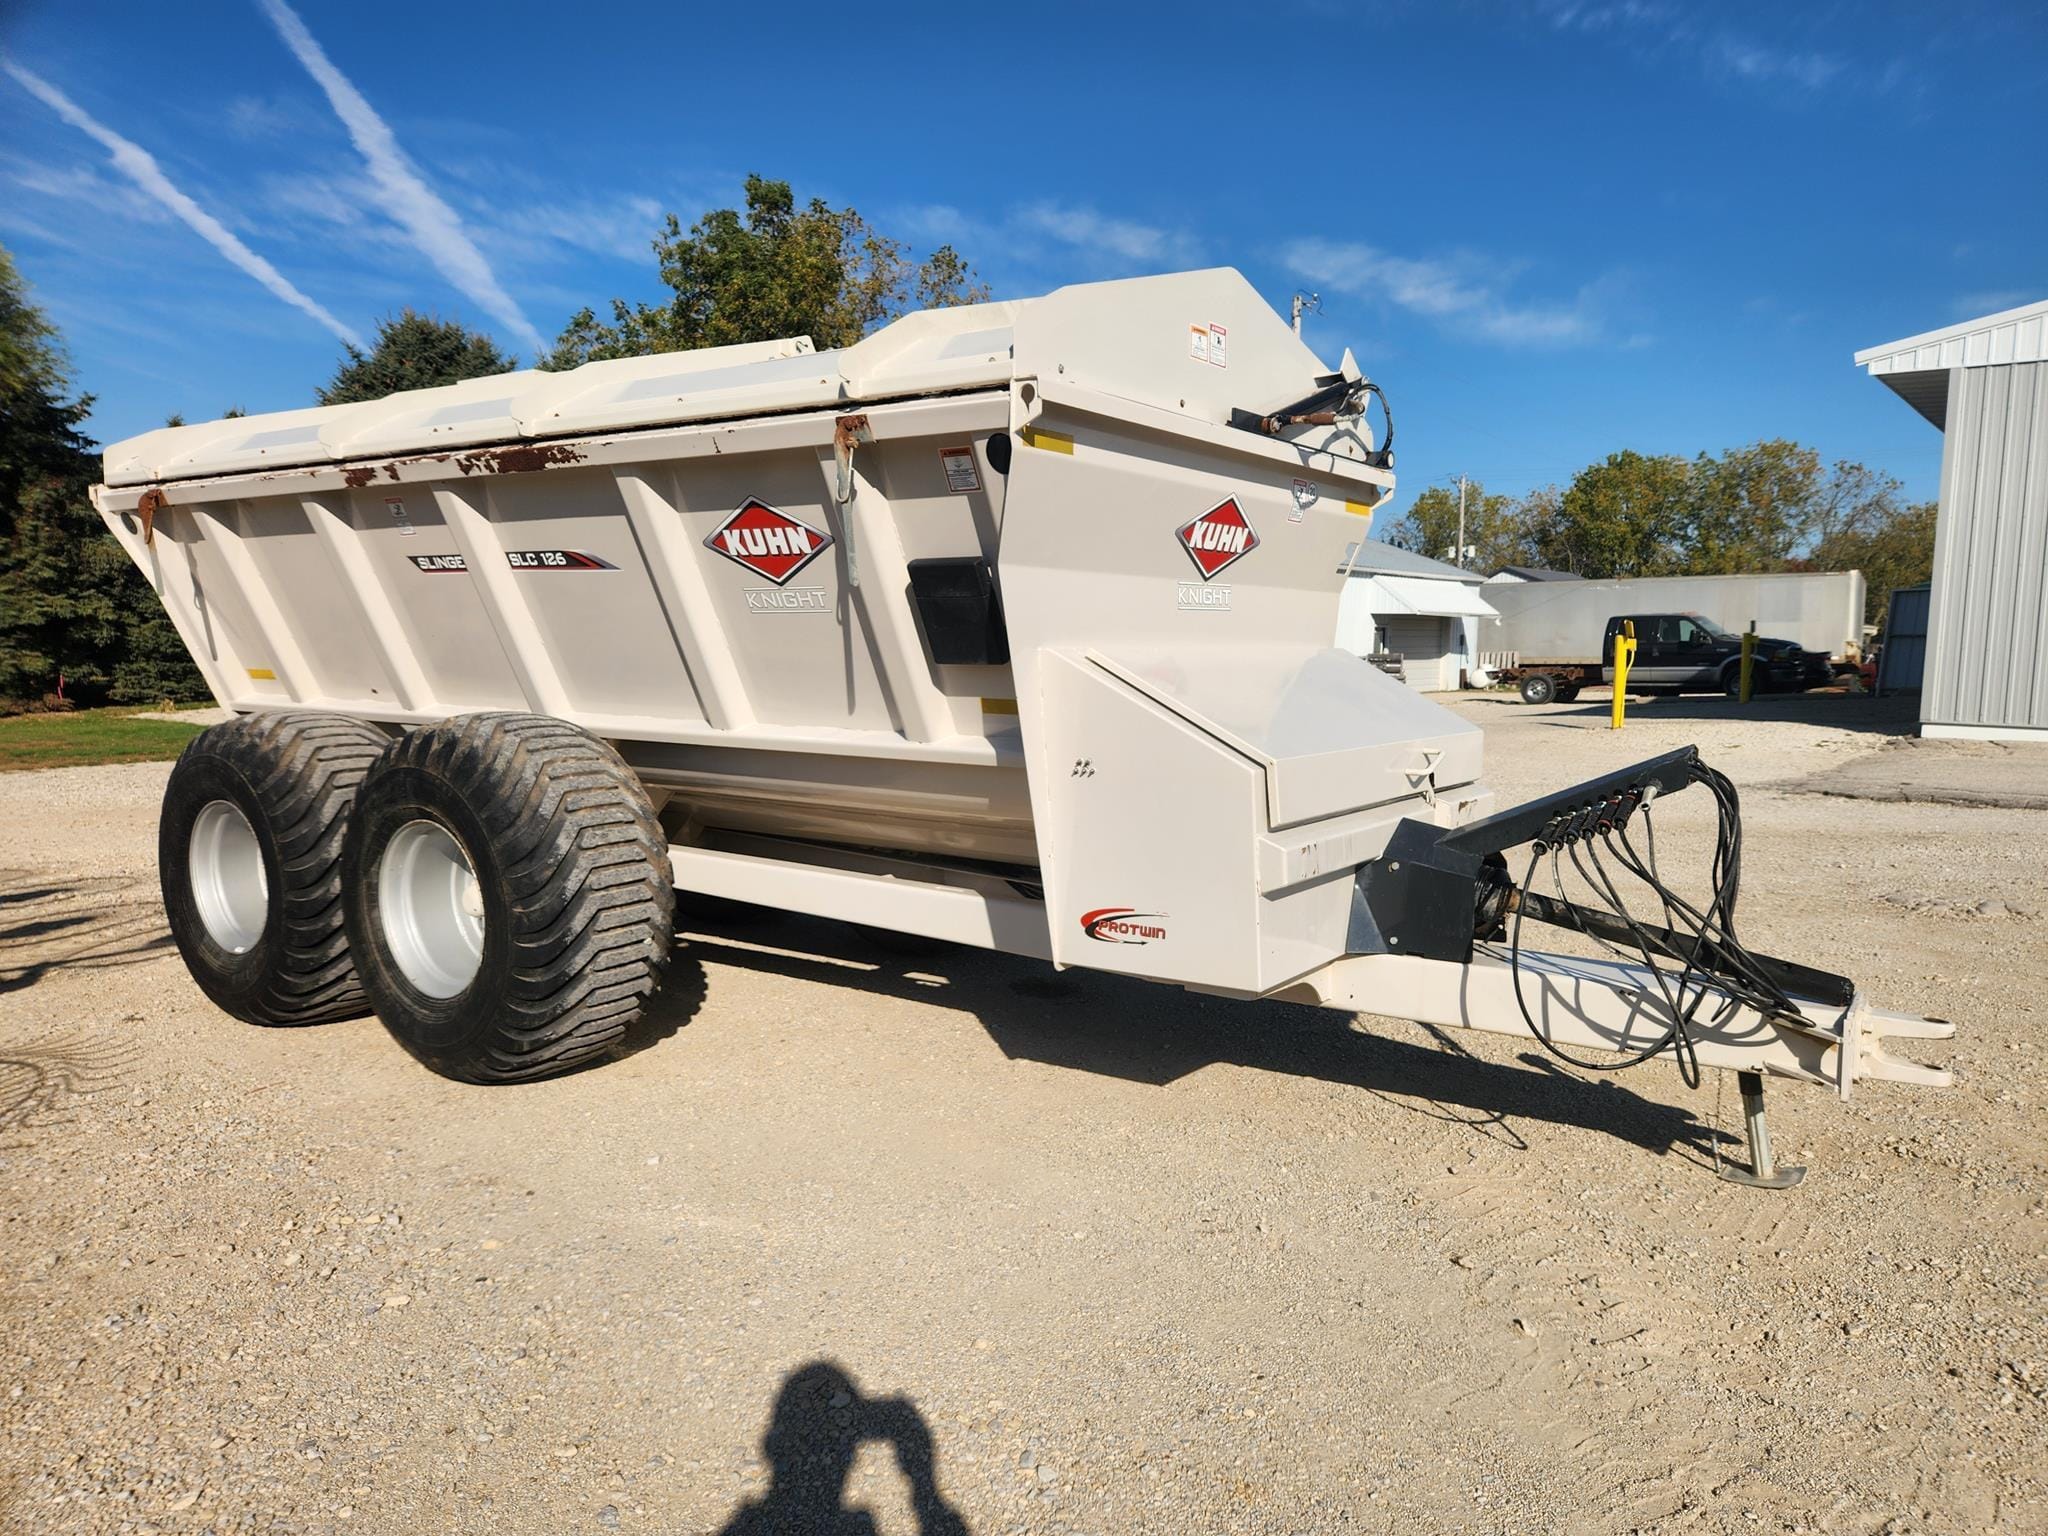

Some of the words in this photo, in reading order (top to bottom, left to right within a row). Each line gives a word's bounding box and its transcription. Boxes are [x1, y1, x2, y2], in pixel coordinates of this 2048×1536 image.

[722, 527, 813, 556] KUHN
[1189, 520, 1249, 553] KUHN
[508, 552, 538, 567] SLC
[540, 552, 567, 566] 126
[745, 592, 826, 609] KNIGHT
[1178, 587, 1231, 606] KNIGHT
[1098, 920, 1166, 940] PROTWIN
